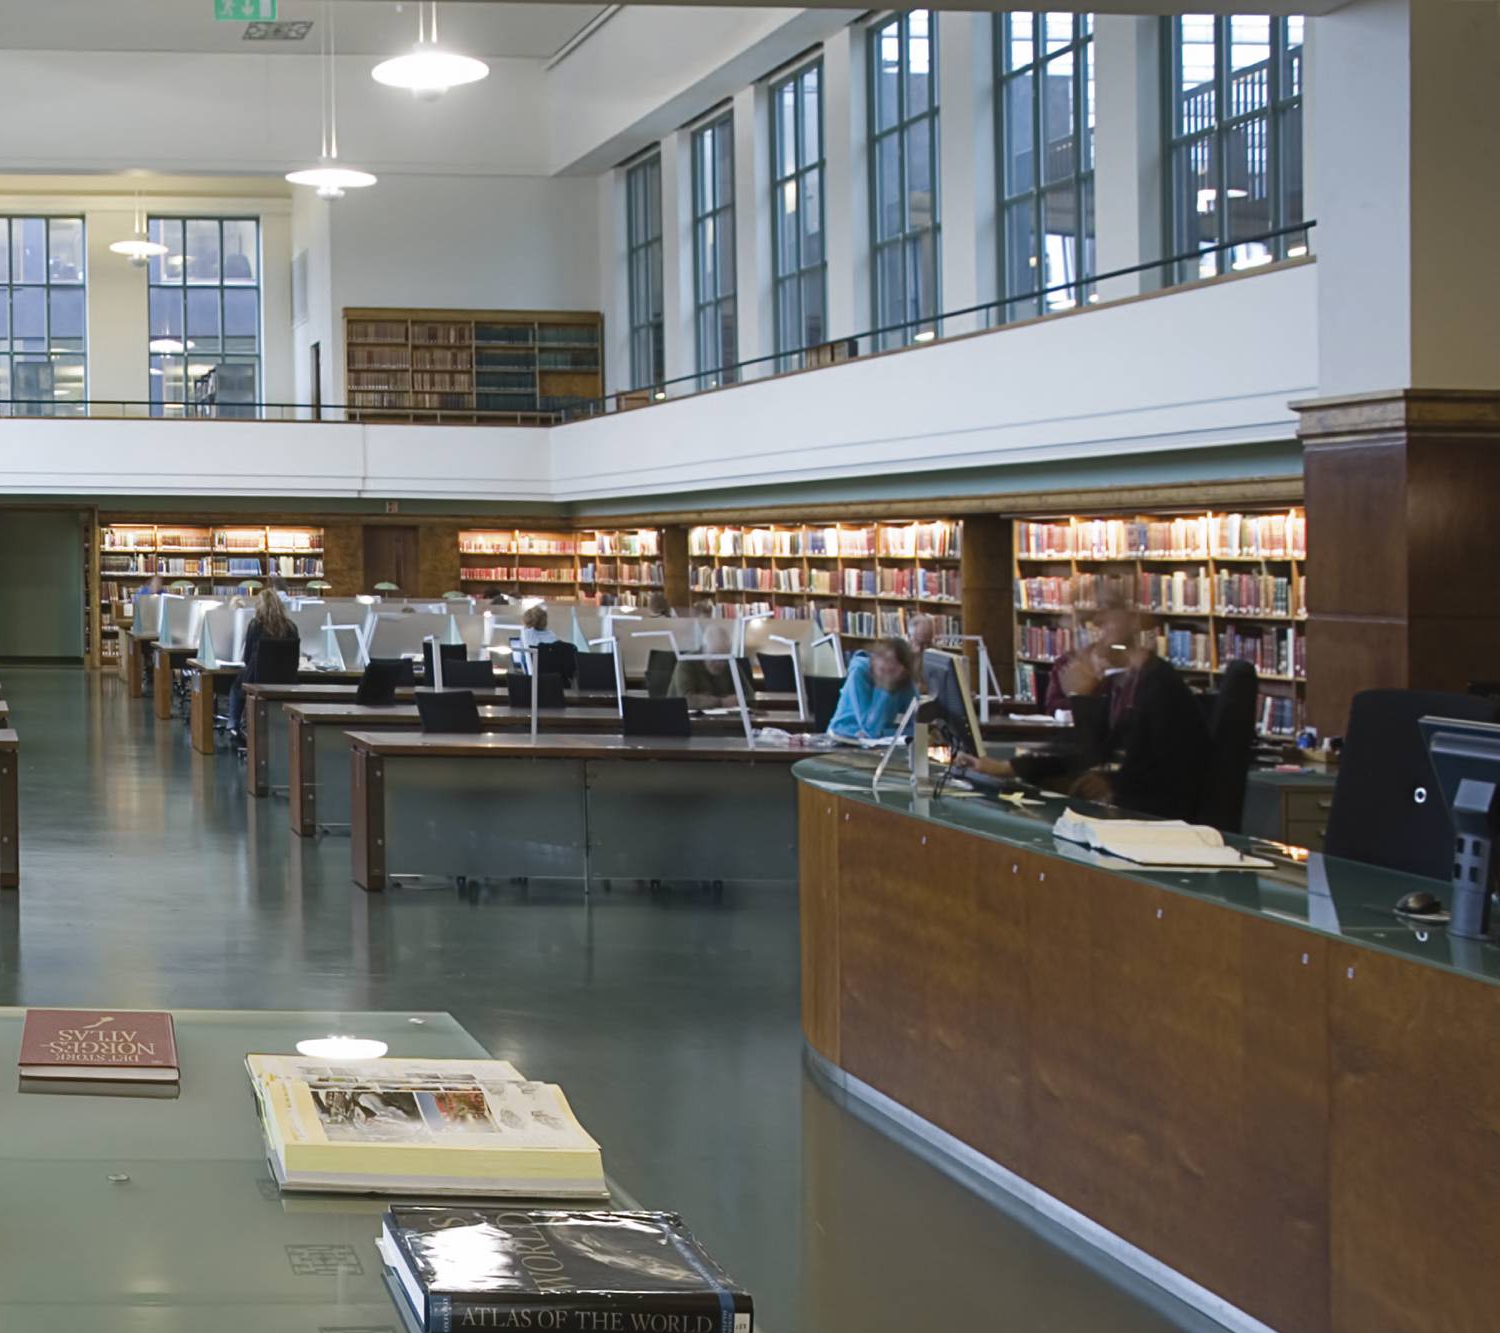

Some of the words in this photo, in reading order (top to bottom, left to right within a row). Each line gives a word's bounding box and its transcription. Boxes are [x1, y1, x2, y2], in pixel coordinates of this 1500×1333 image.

[58, 1030, 137, 1042] ATLAS
[50, 1041, 156, 1056] NORGES
[55, 1053, 102, 1062] STORE
[108, 1054, 139, 1063] DET
[461, 1306, 533, 1329] ATLAS
[536, 1309, 569, 1330] OF
[574, 1310, 628, 1332] THE
